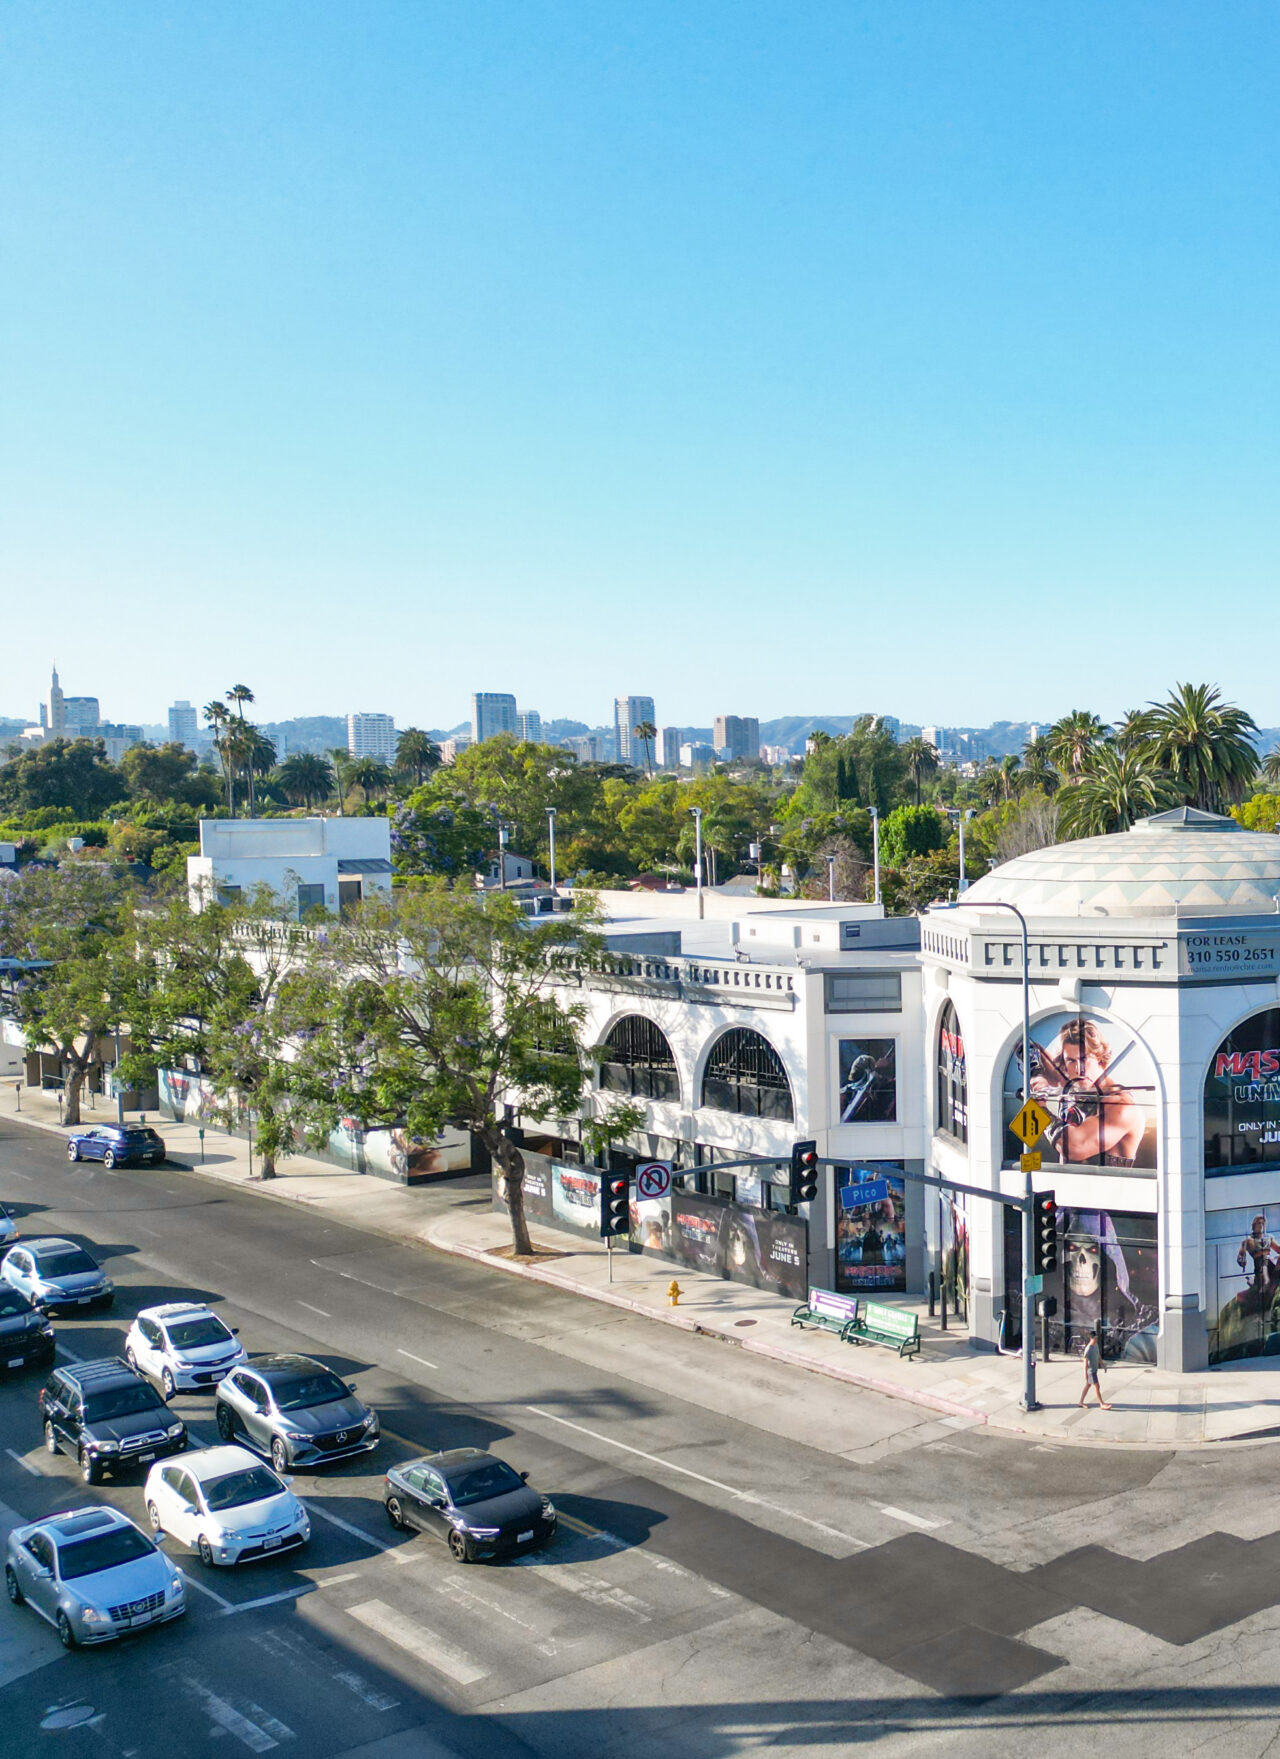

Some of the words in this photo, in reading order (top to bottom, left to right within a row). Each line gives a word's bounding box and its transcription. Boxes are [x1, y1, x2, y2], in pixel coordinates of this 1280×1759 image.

[1187, 937, 1210, 946] FOR
[1214, 935, 1247, 945] LEASE
[1187, 951, 1211, 963] 310
[1216, 949, 1240, 962] 550
[1244, 948, 1275, 960] 2651
[1239, 1121, 1265, 1132] ONLY
[1266, 1120, 1276, 1129] IN
[852, 1189, 877, 1200] Pico
[770, 1251, 792, 1264] JUNE
[794, 1255, 800, 1266] 5
